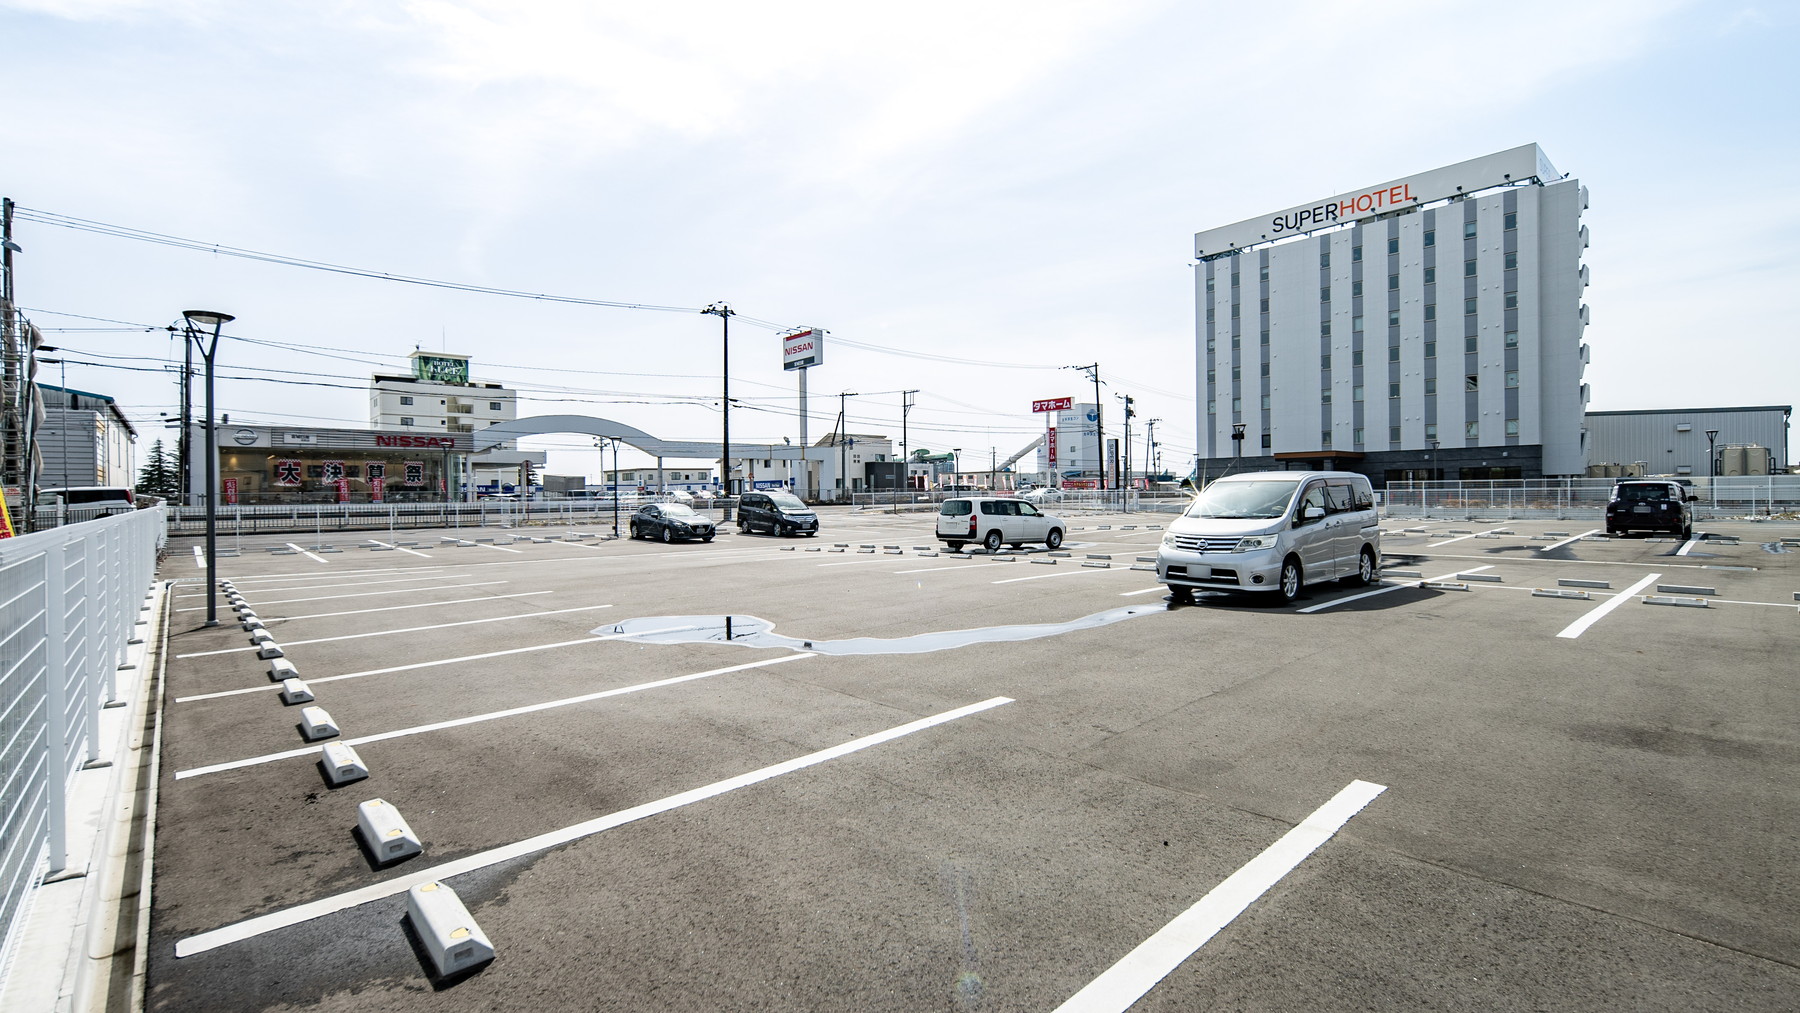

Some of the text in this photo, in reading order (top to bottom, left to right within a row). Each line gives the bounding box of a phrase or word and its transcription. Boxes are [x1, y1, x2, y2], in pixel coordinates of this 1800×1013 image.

[785, 342, 814, 356] NISSAN
[1033, 400, 1071, 411] タマホーム
[376, 435, 455, 448] NISSAN
